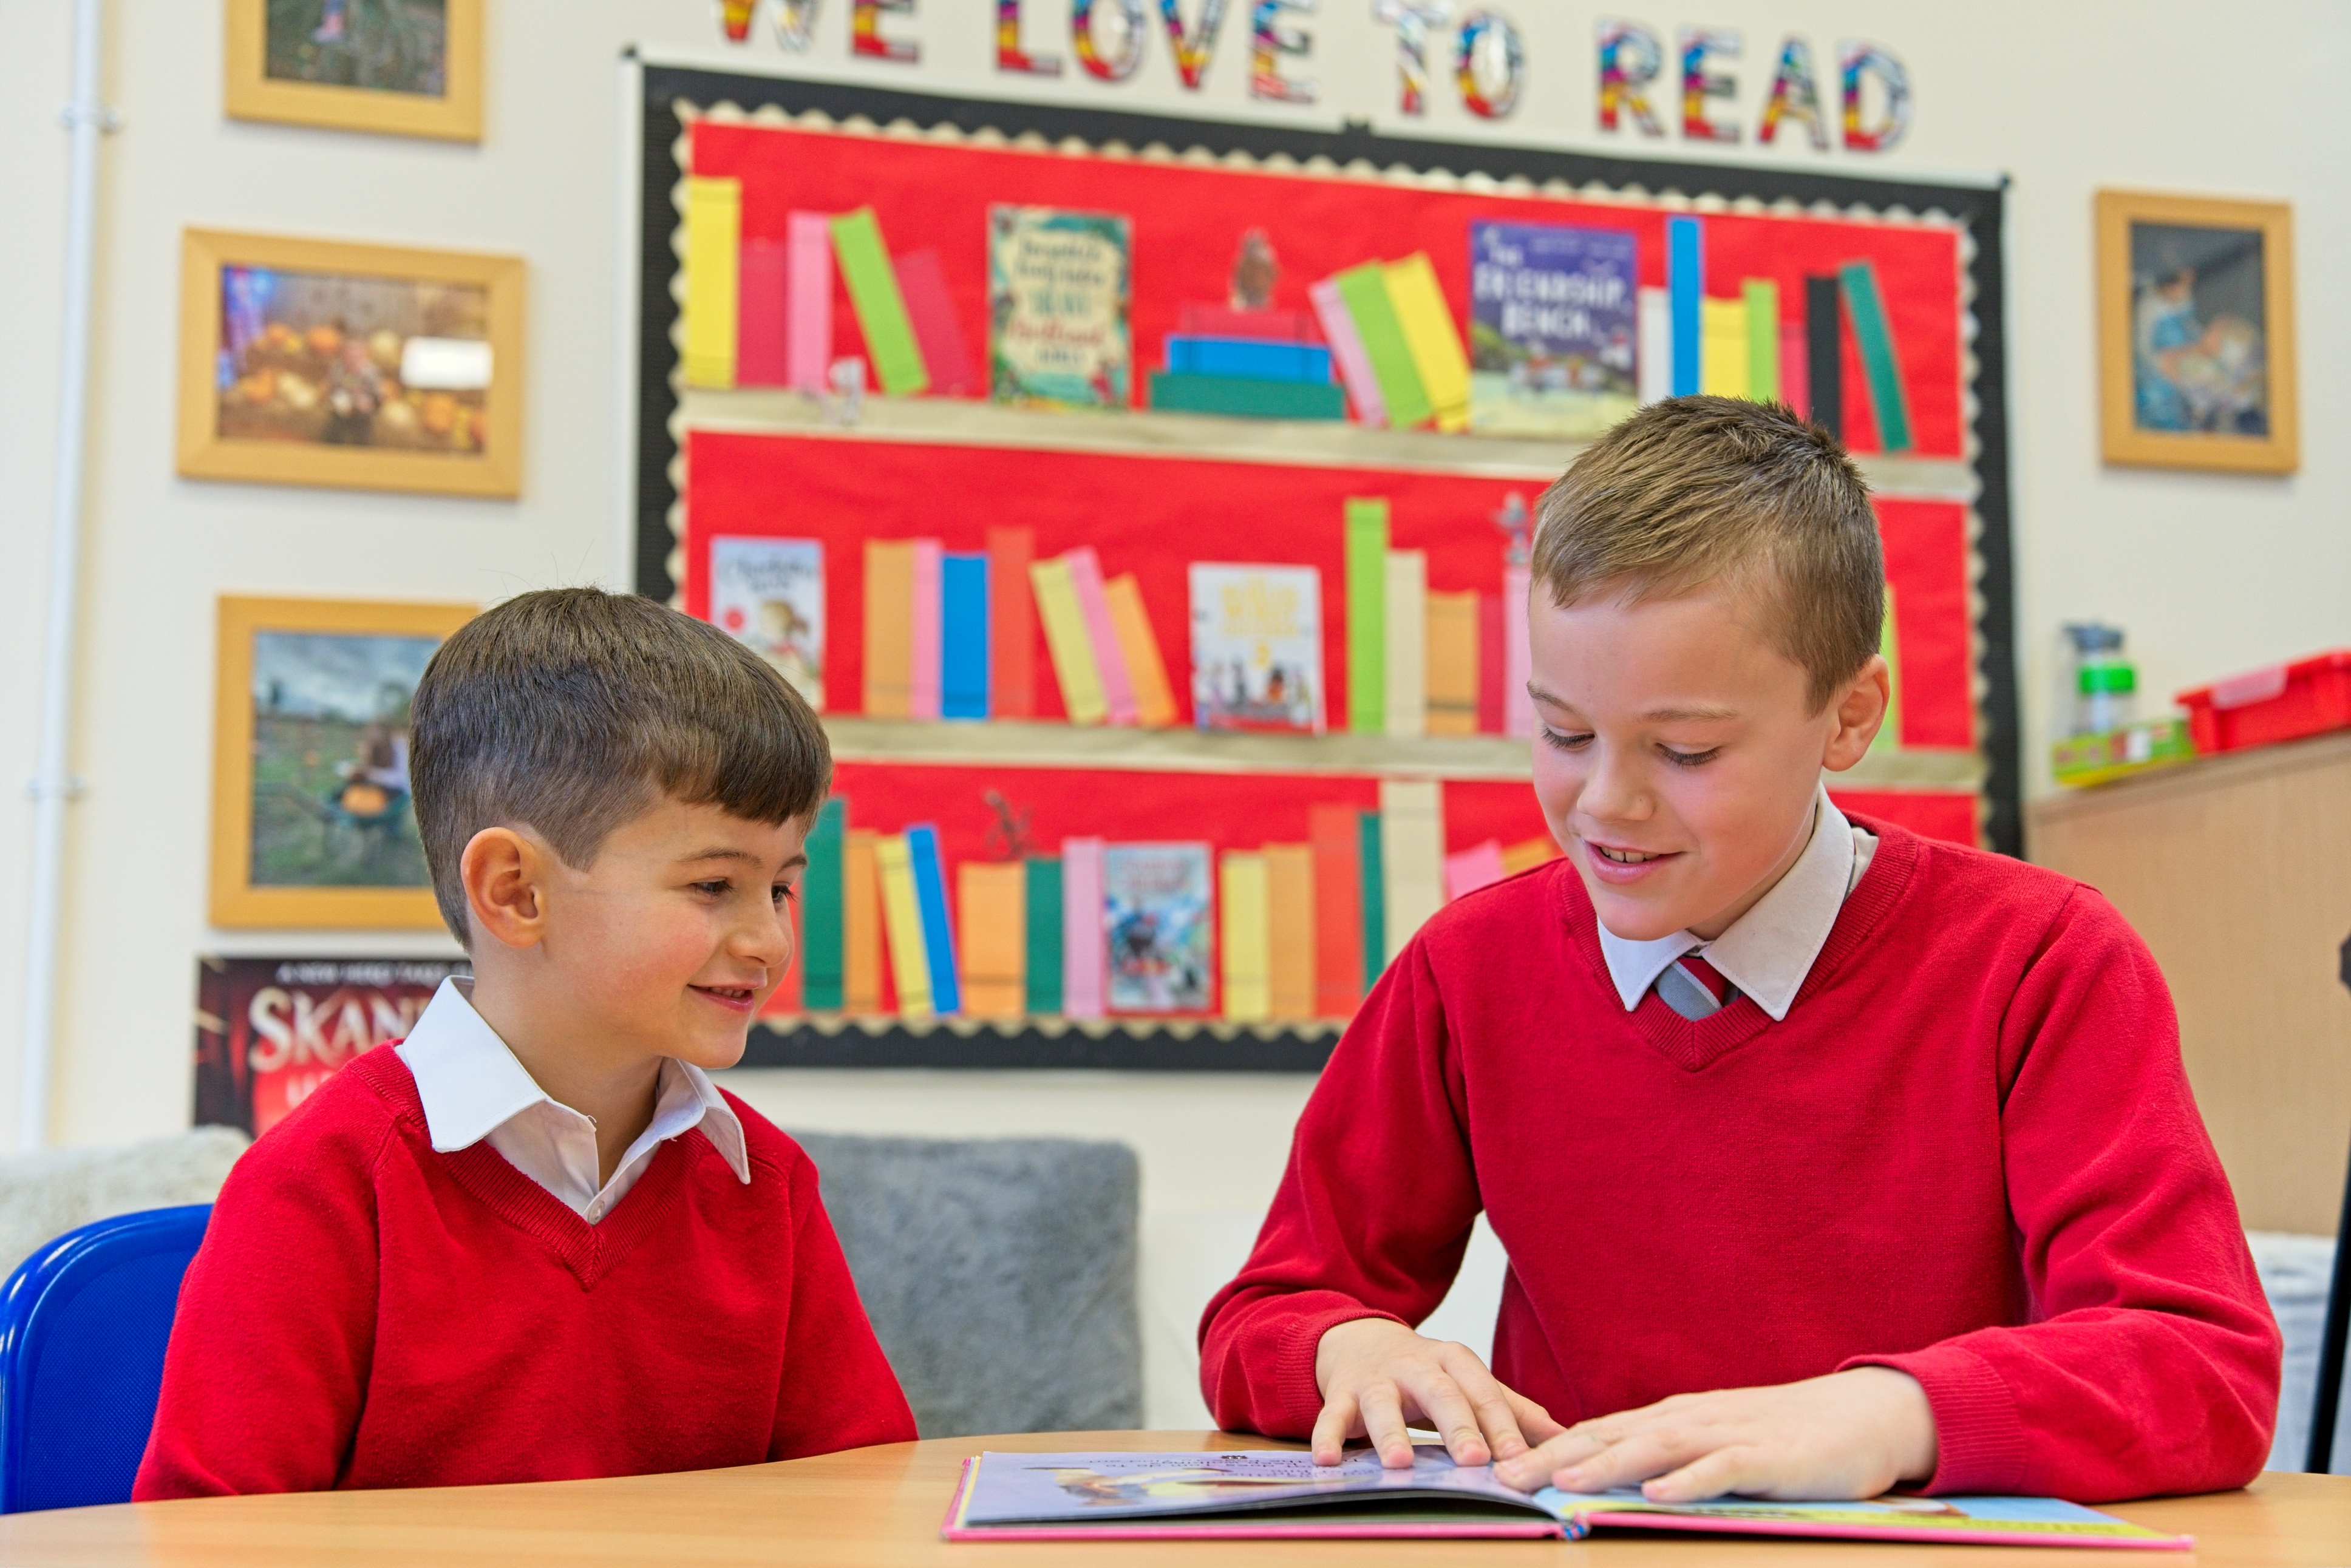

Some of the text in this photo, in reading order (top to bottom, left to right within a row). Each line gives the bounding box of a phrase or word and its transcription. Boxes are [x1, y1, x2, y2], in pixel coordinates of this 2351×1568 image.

[996, 0, 1321, 103] LOVE
[1373, 0, 1525, 119] TO
[1594, 17, 1911, 152] READ
